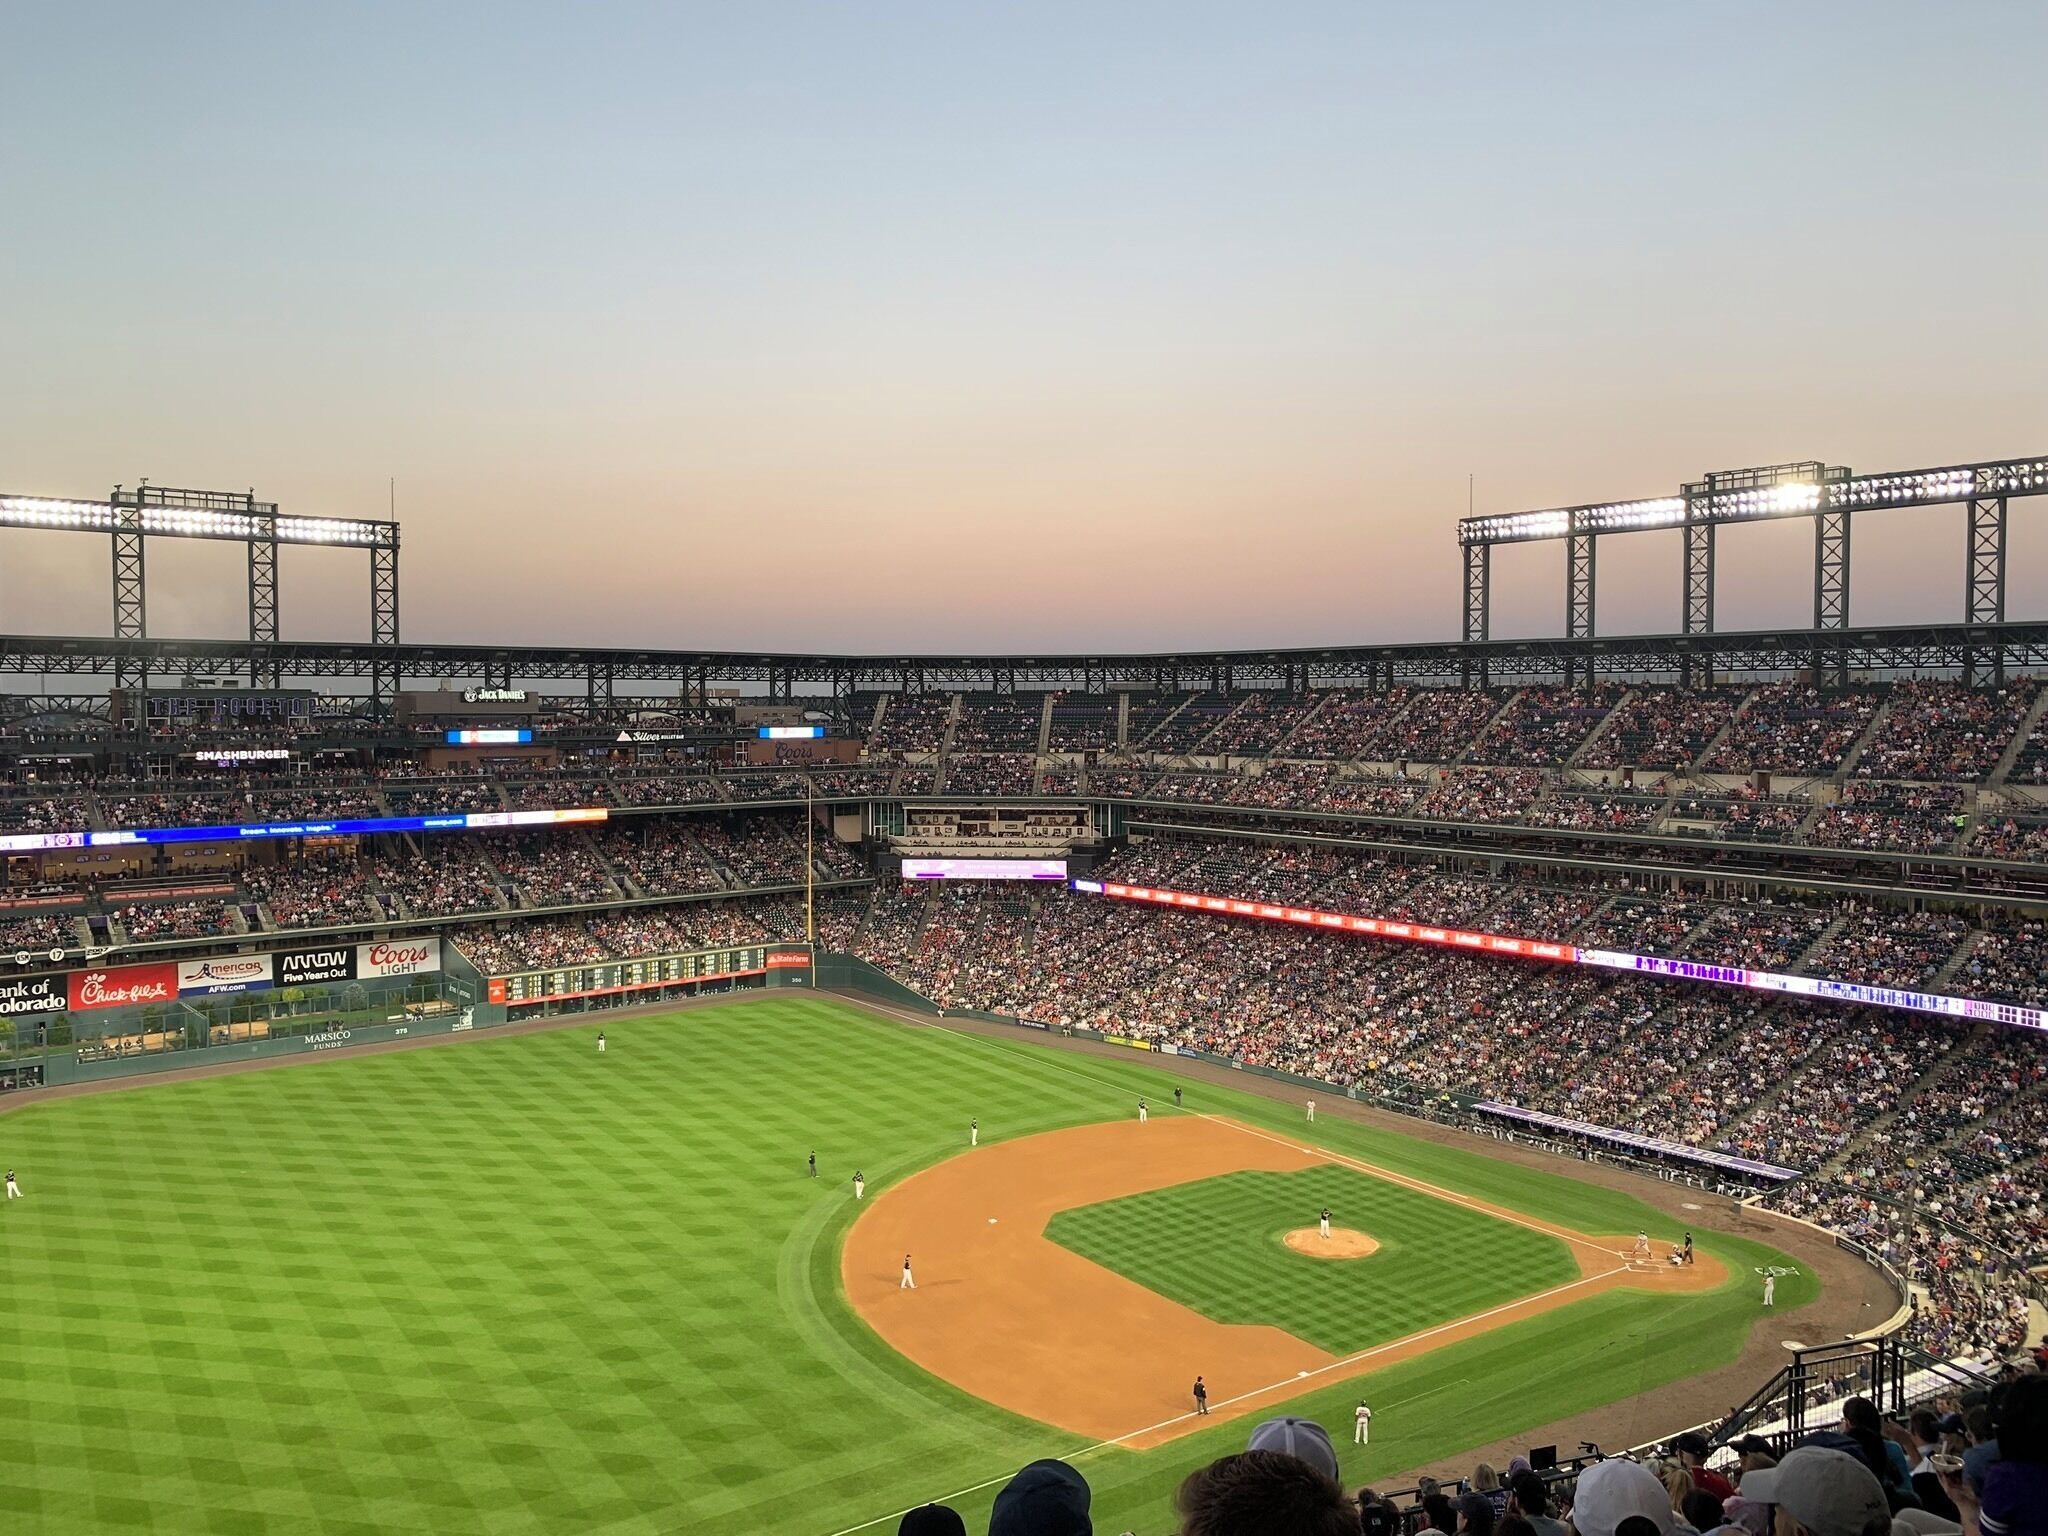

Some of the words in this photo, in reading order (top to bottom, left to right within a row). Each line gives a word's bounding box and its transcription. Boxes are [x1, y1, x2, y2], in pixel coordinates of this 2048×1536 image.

[478, 688, 497, 700] JACK
[498, 688, 526, 700] DANIEL'S
[152, 697, 196, 716] THE
[214, 697, 317, 716] ROOFTOP
[632, 731, 660, 742] Silver
[195, 750, 290, 761] SMASHBURGER
[775, 741, 813, 759] Coors
[52, 951, 62, 960] 17
[282, 951, 347, 971] ARROW
[369, 943, 429, 966] Coors
[192, 961, 263, 978] American
[284, 973, 303, 983] Five
[304, 970, 329, 981] Years
[330, 968, 347, 978] Out
[380, 962, 418, 976] LIGHT
[0, 981, 29, 998] ank
[32, 978, 50, 995] of
[81, 979, 168, 1005] Chick-fil-A
[208, 984, 246, 994] AFW.com
[0, 993, 66, 1014] olorado
[304, 1030, 351, 1044] MARSICO
[313, 1041, 342, 1051] FUNDS
